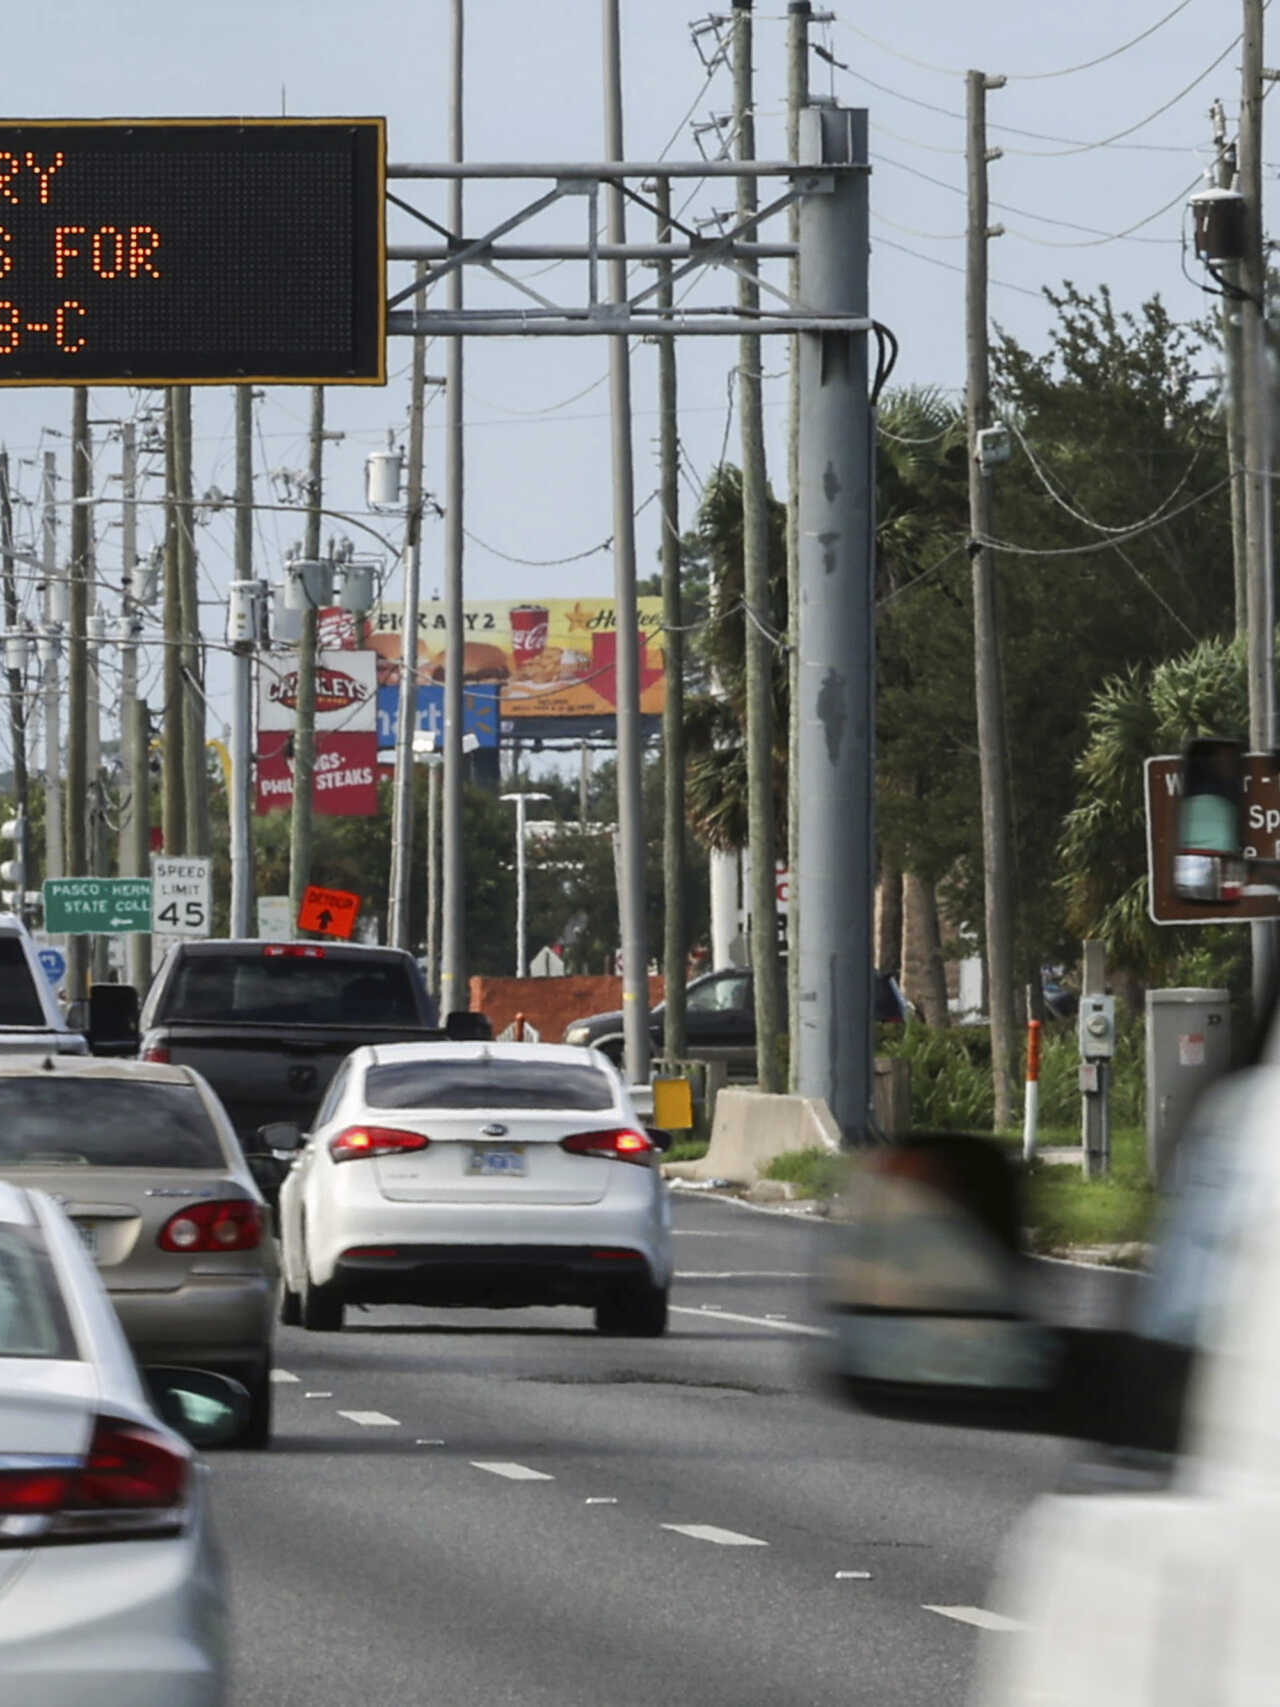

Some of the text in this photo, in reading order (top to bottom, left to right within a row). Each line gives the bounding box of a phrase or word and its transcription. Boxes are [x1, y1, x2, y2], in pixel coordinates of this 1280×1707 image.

[54, 226, 160, 279] FOR
[378, 613, 427, 630] PIK
[483, 613, 495, 629] 2
[316, 768, 373, 791] STEAKS
[157, 864, 206, 879] SPEED
[52, 884, 100, 896] PASCO
[161, 884, 200, 896] LIMIT
[64, 901, 108, 913] STATE
[158, 901, 205, 927] 45
